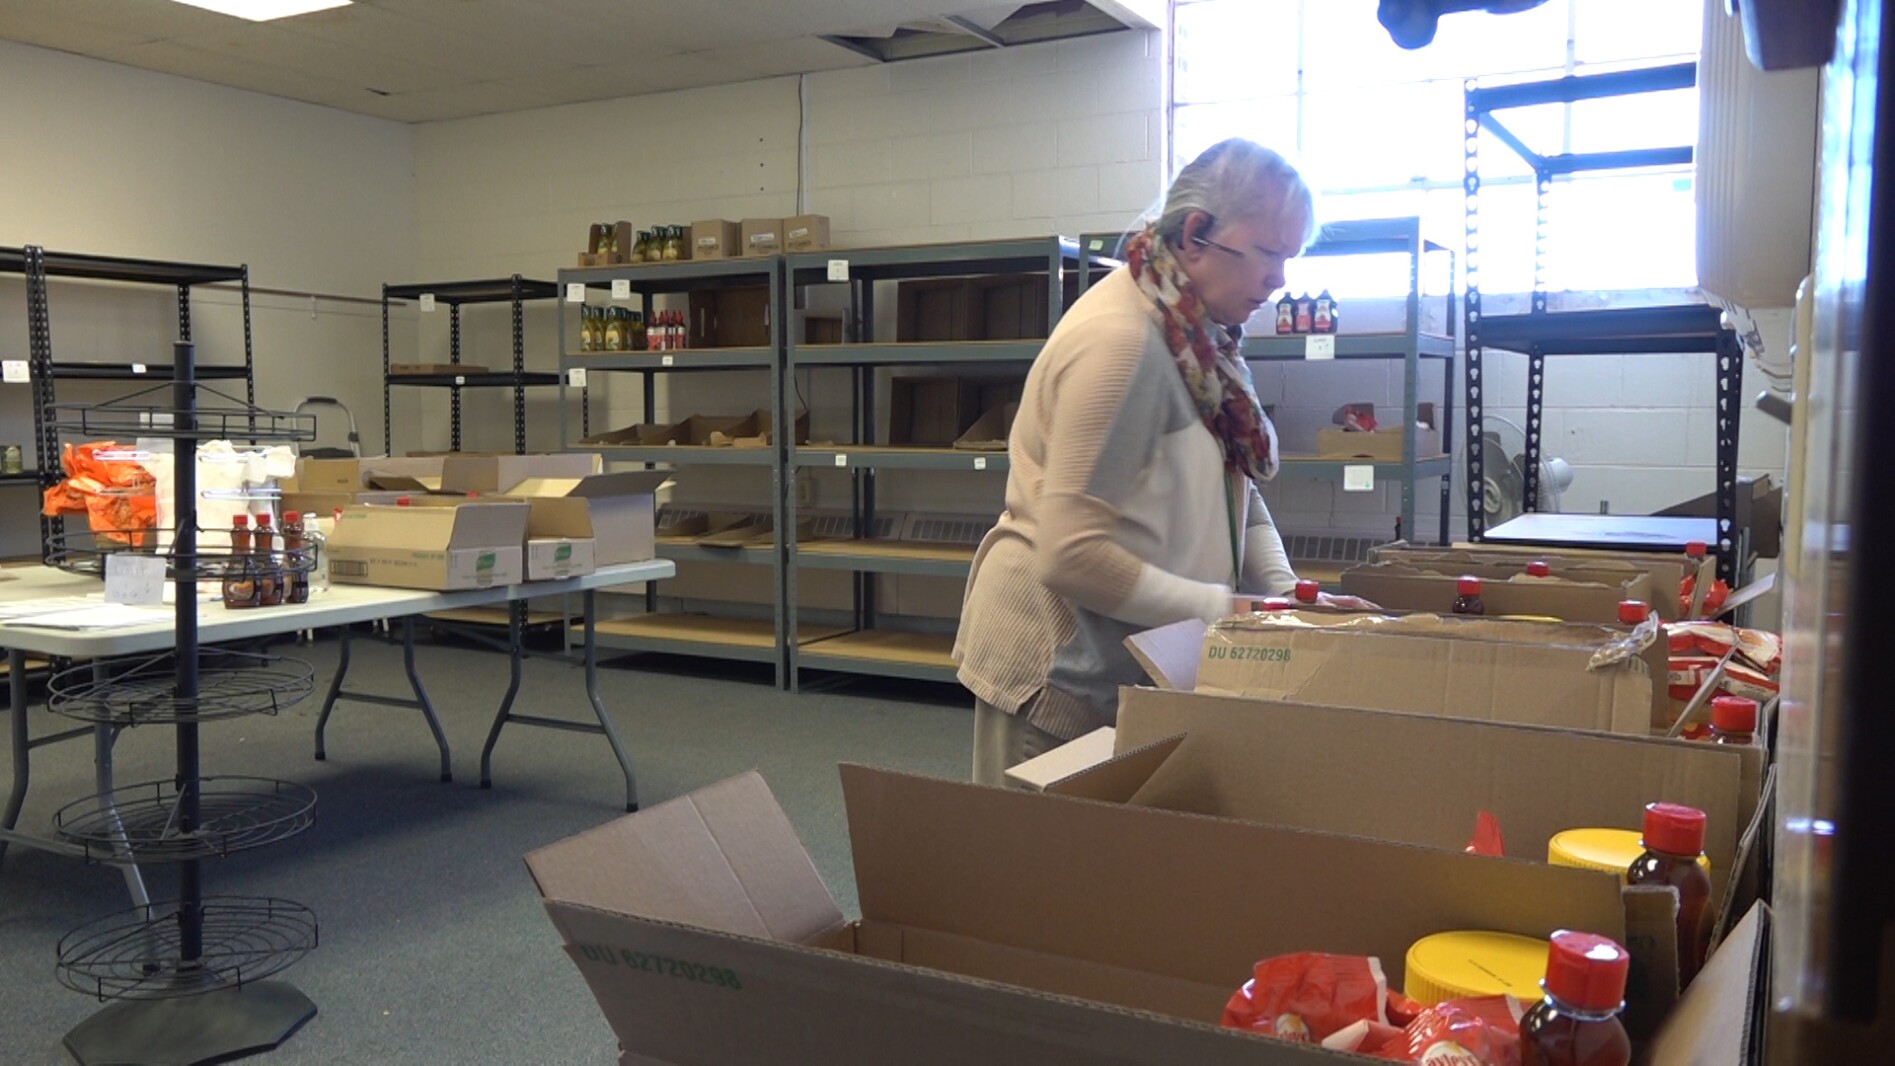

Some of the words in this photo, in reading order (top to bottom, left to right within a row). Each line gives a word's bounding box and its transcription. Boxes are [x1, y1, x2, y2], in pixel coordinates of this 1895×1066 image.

[1208, 645, 1226, 659] DU
[1230, 647, 1291, 660] 62720298
[580, 943, 617, 966] DU
[620, 949, 742, 990] 62720298
